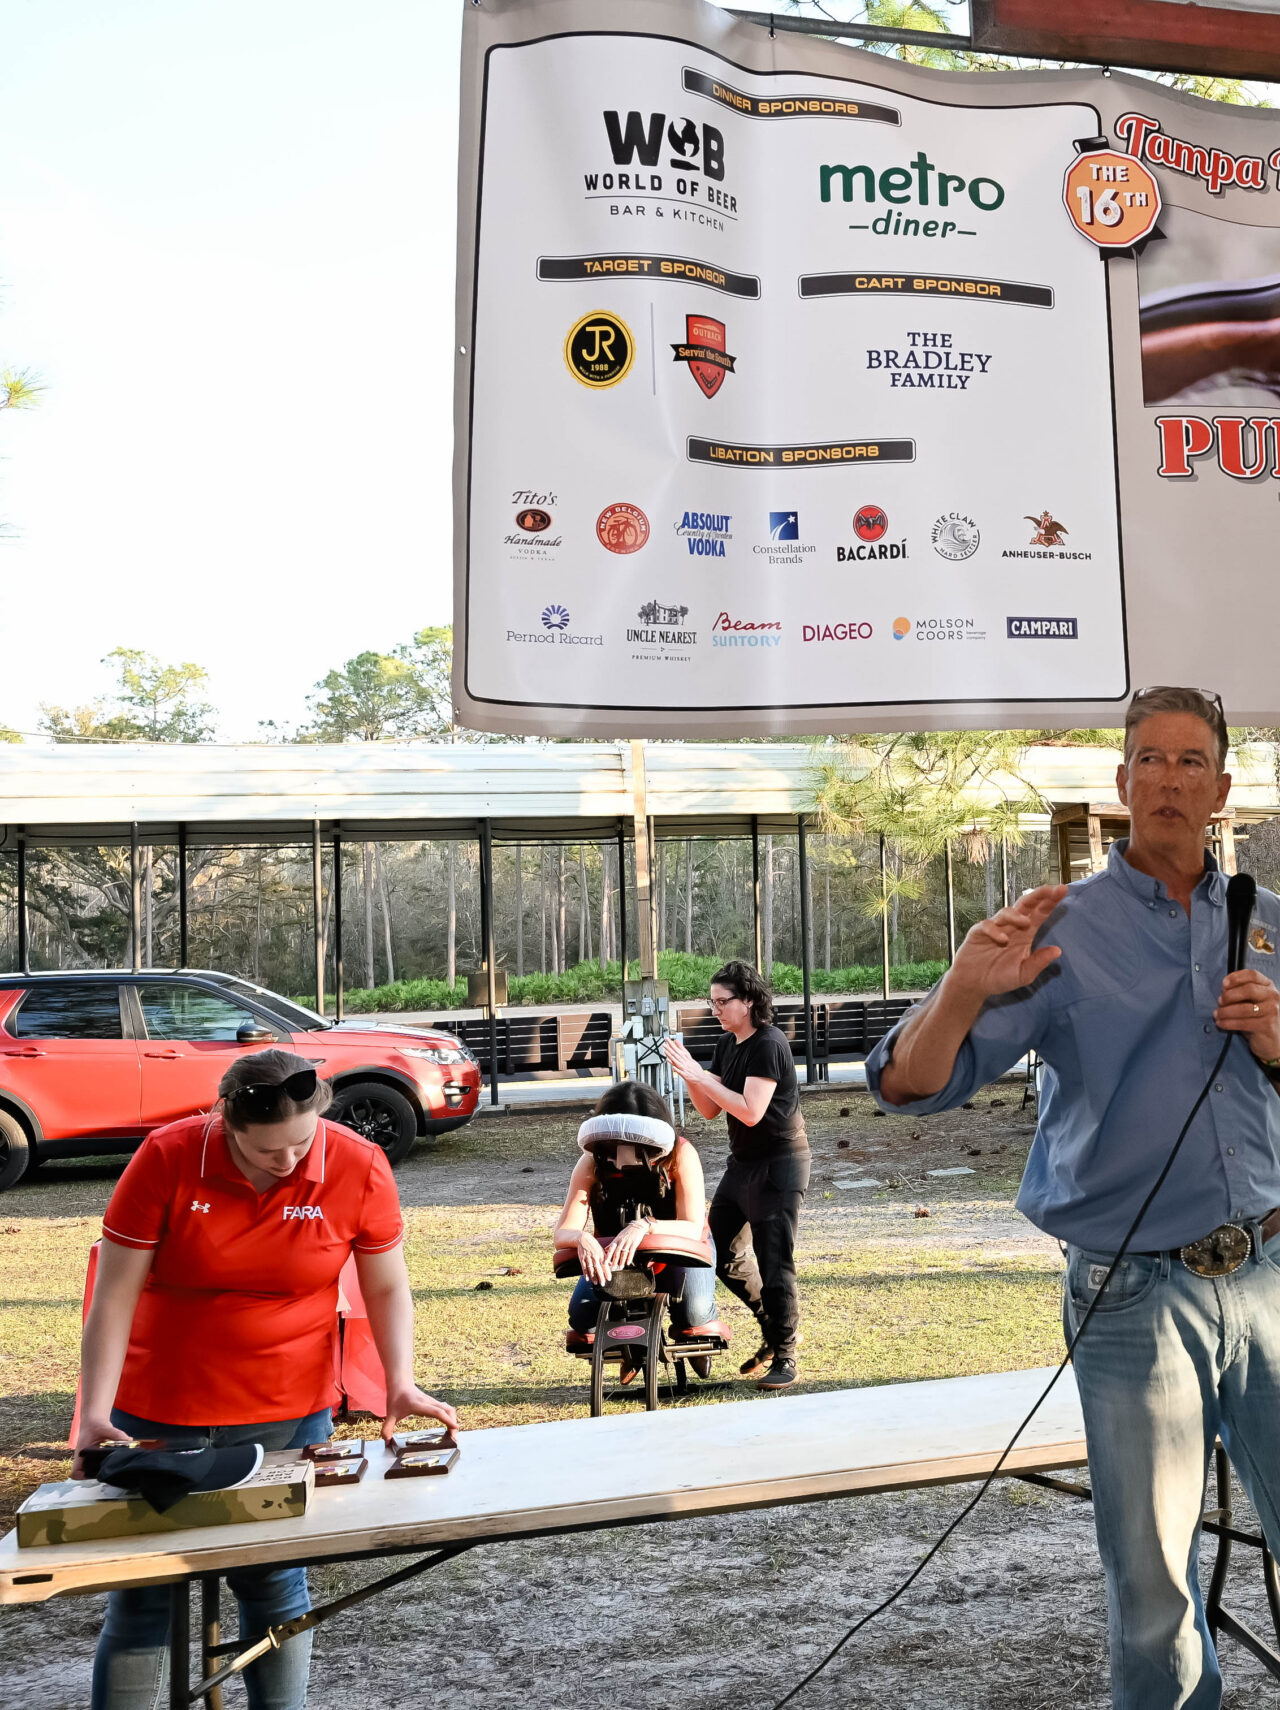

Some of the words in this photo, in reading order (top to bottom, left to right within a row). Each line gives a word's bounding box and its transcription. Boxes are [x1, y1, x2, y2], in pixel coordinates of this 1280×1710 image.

[712, 84, 751, 110] DINNER
[758, 101, 859, 114] SPONSORS
[1115, 112, 1267, 193] Tampa
[820, 152, 1005, 211] metro
[1089, 163, 1129, 182] THE
[584, 173, 663, 191] WORLD
[676, 178, 699, 197] OF
[707, 186, 738, 213] BEER
[610, 205, 646, 216] BAR
[656, 207, 664, 217] &
[673, 209, 724, 232] KITCHEN
[584, 260, 652, 273] TARGET
[661, 261, 726, 287] SPONSOR
[855, 277, 905, 289] CART
[914, 279, 1001, 296] SPONSOR
[582, 326, 615, 361] JR
[693, 327, 721, 341] OUTBACK
[907, 332, 953, 348] THE
[678, 347, 705, 358] Servin'
[706, 350, 715, 360] the
[715, 353, 731, 367] South
[866, 350, 992, 373] BRADLEY
[890, 373, 970, 390] FAMILY
[710, 446, 774, 462] LIBATION
[782, 445, 879, 462] SPONSORS
[511, 490, 557, 506] Tito's
[600, 511, 612, 529] NEW
[615, 506, 646, 531] BELGIUM
[681, 511, 731, 533] ABSOLUT
[931, 515, 948, 544] WHITE
[949, 512, 977, 528] CLAW
[504, 534, 562, 547] Handmade
[688, 538, 726, 557] VODKA
[752, 544, 816, 554] Constellation
[768, 554, 803, 564] Brands
[1002, 551, 1092, 561] ANHEUSER-BUSCH
[712, 612, 782, 631] Beam
[916, 618, 974, 629] MOLSON
[1011, 620, 1073, 636] CAMPARI
[506, 630, 555, 644] Pernod
[559, 633, 604, 646] Ricard
[626, 629, 657, 643] UNCLE
[659, 630, 697, 644] NEAREST
[802, 622, 873, 642] DIAGEO
[916, 630, 964, 641] COORS
[283, 1205, 324, 1220] FARA
